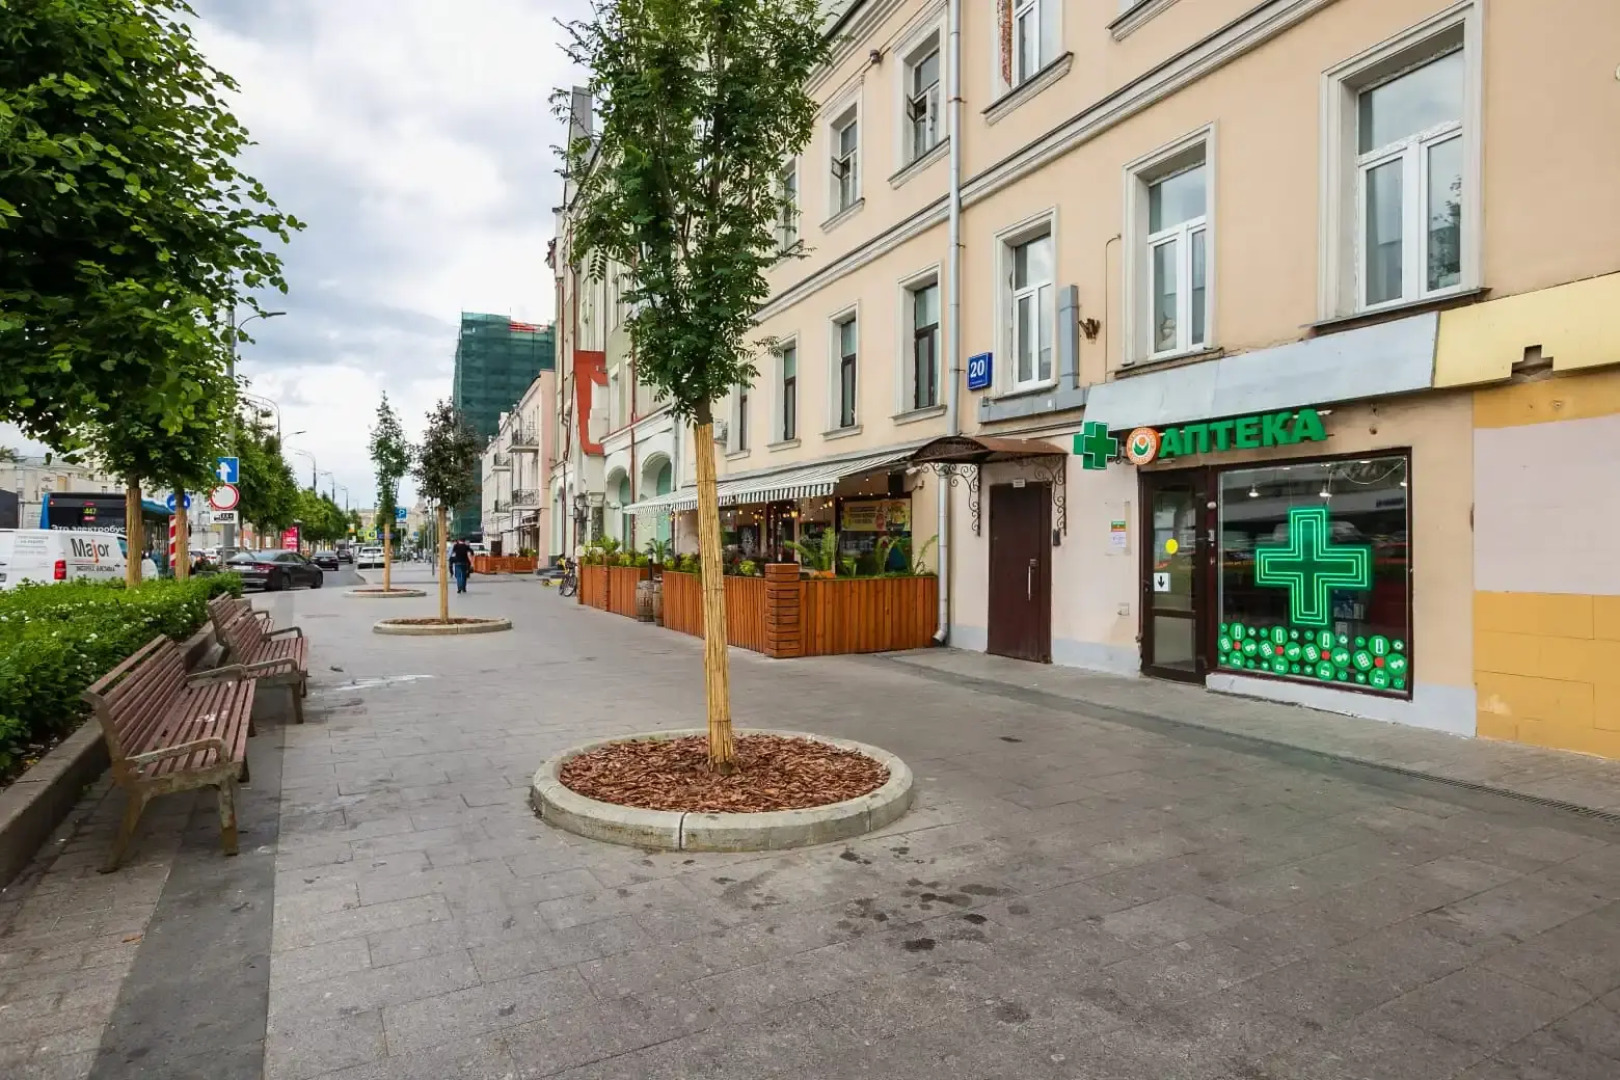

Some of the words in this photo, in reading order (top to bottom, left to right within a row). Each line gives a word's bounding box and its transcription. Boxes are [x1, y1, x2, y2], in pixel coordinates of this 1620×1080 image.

[970, 360, 985, 378] 20
[1158, 408, 1328, 459] АПТЕКА
[70, 538, 109, 563] Major
